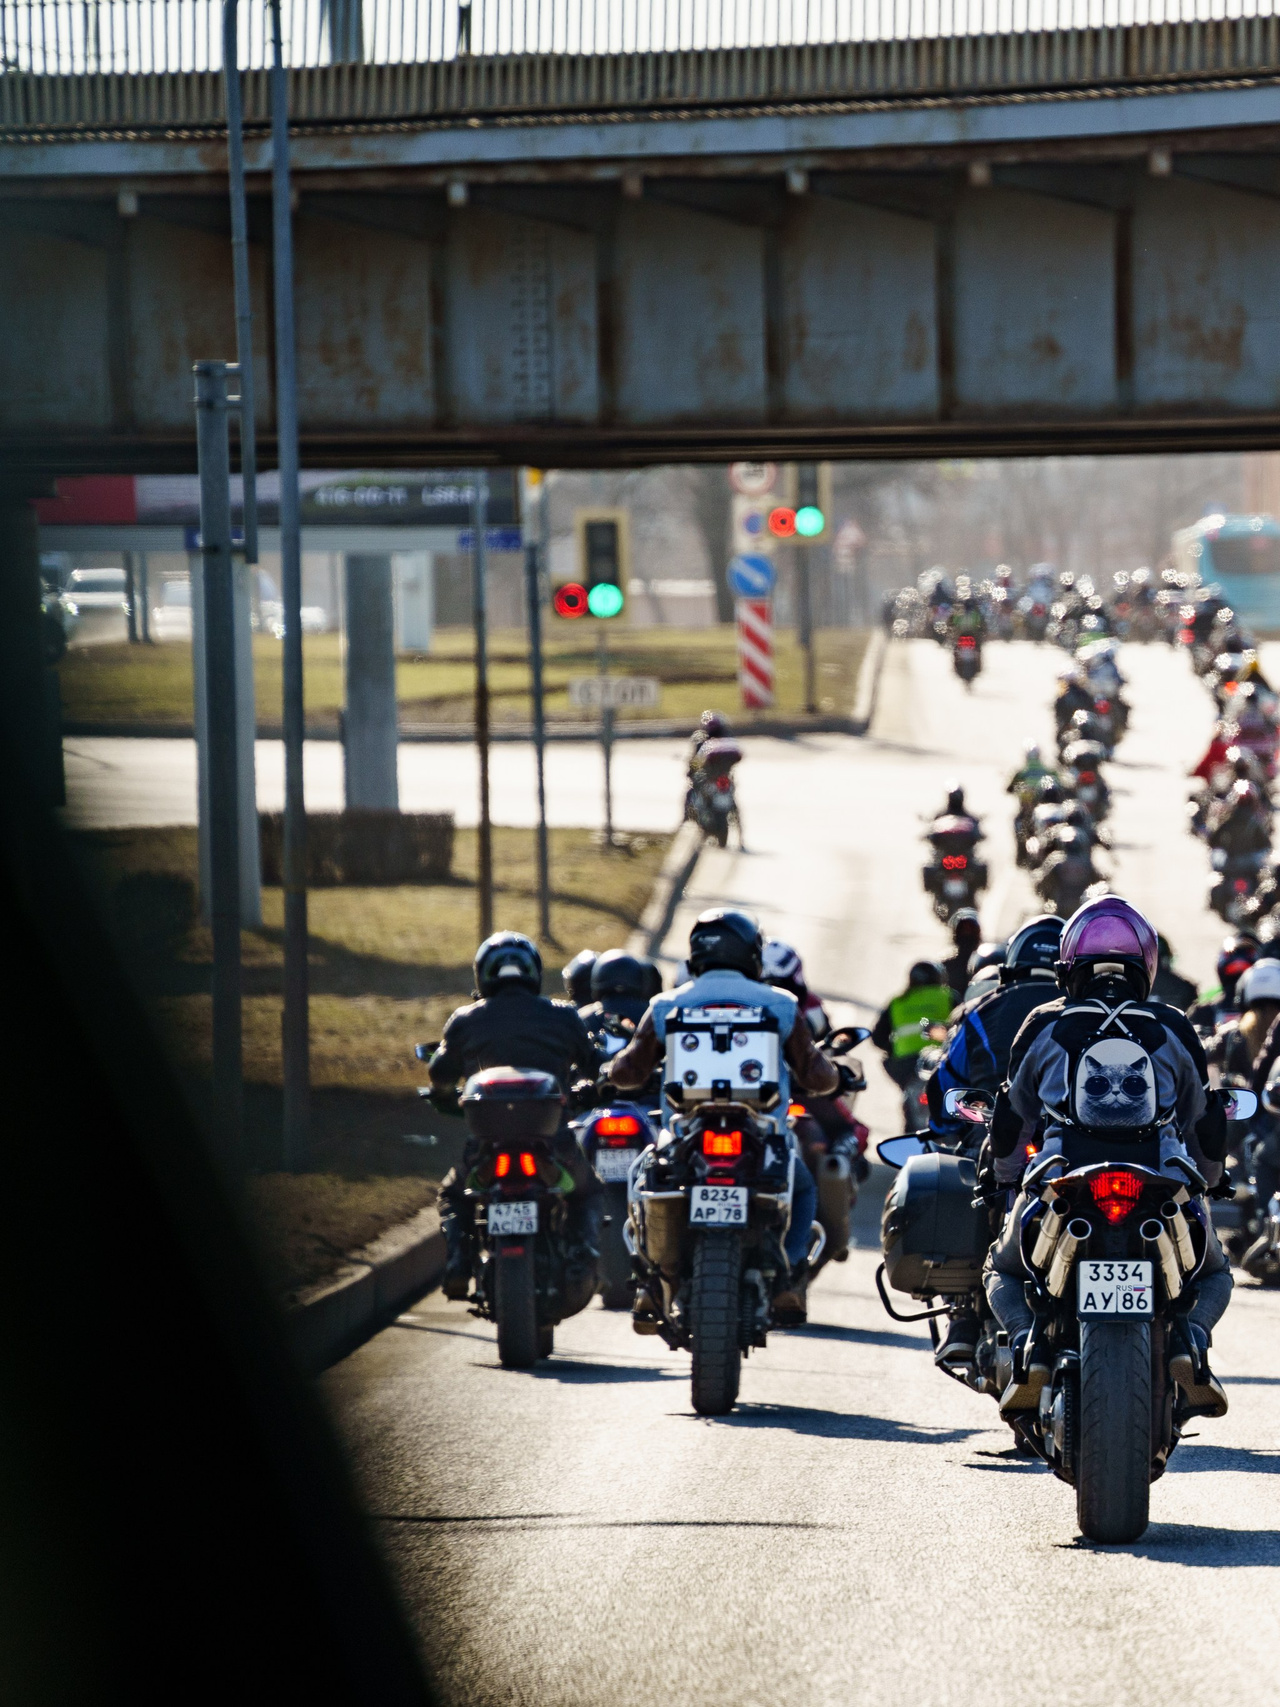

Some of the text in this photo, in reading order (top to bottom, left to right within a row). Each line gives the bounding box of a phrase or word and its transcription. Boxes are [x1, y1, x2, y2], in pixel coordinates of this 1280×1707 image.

[700, 1189, 740, 1201] 8234
[723, 1208, 742, 1220] 78
[1089, 1263, 1143, 1282] 3334
[1122, 1292, 1148, 1310] 86
